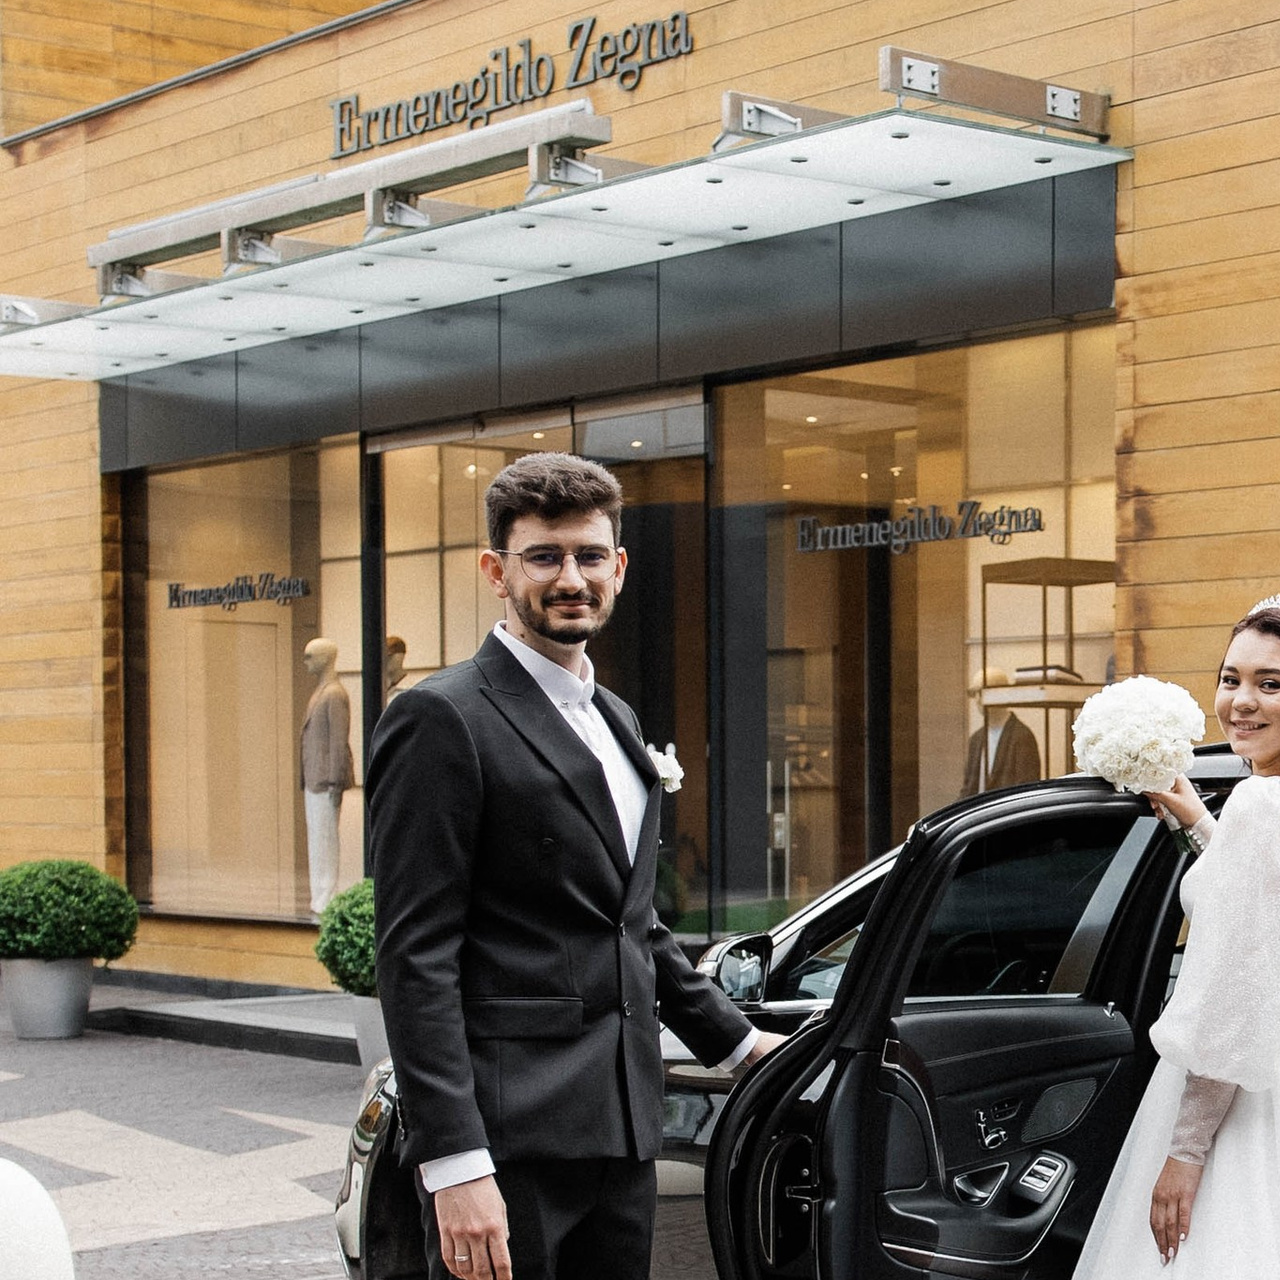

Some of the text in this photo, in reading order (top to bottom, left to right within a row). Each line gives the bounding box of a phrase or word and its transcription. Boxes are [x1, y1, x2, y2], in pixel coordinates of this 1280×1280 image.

[329, 10, 693, 159] Ermenegildo Zegna
[796, 500, 1045, 554] Ermenegildo Zegna
